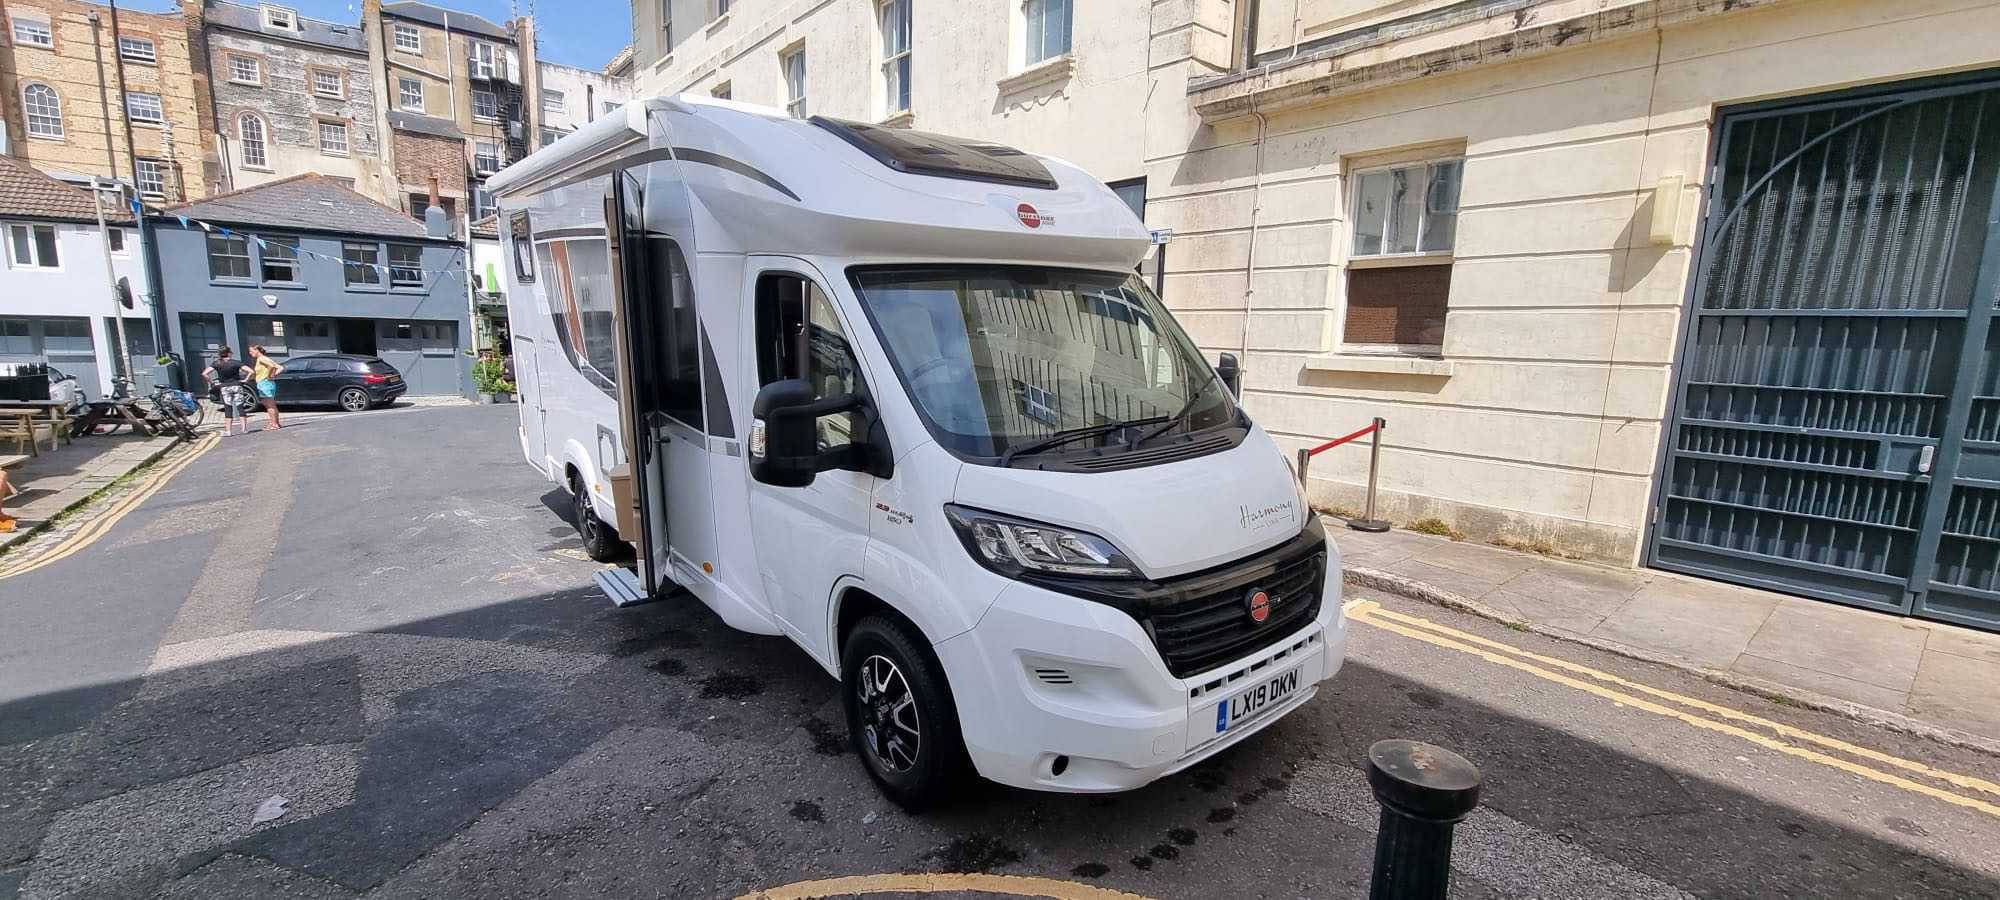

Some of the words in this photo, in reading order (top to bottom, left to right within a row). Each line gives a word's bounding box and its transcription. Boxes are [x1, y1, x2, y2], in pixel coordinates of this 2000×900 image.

[1240, 500, 1295, 528] Harmony
[1231, 685, 1267, 721] LX19
[1270, 668, 1298, 702] DKN
